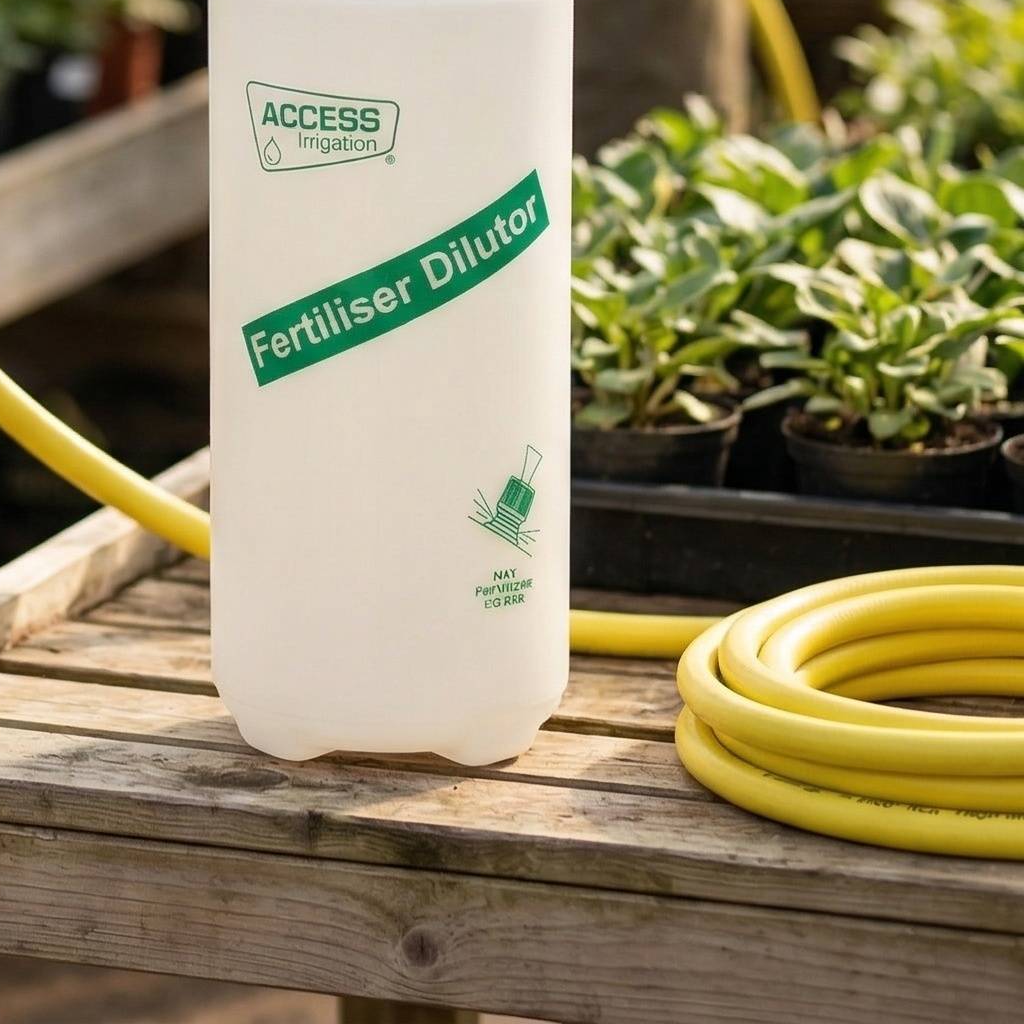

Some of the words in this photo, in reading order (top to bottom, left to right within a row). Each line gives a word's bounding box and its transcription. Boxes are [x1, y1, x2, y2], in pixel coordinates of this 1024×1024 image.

[261, 101, 381, 133] ACCESS
[298, 131, 377, 154] Irrigation
[250, 276, 411, 369] Fertiliser
[419, 194, 537, 290] Dilutor
[493, 568, 517, 581] NAY
